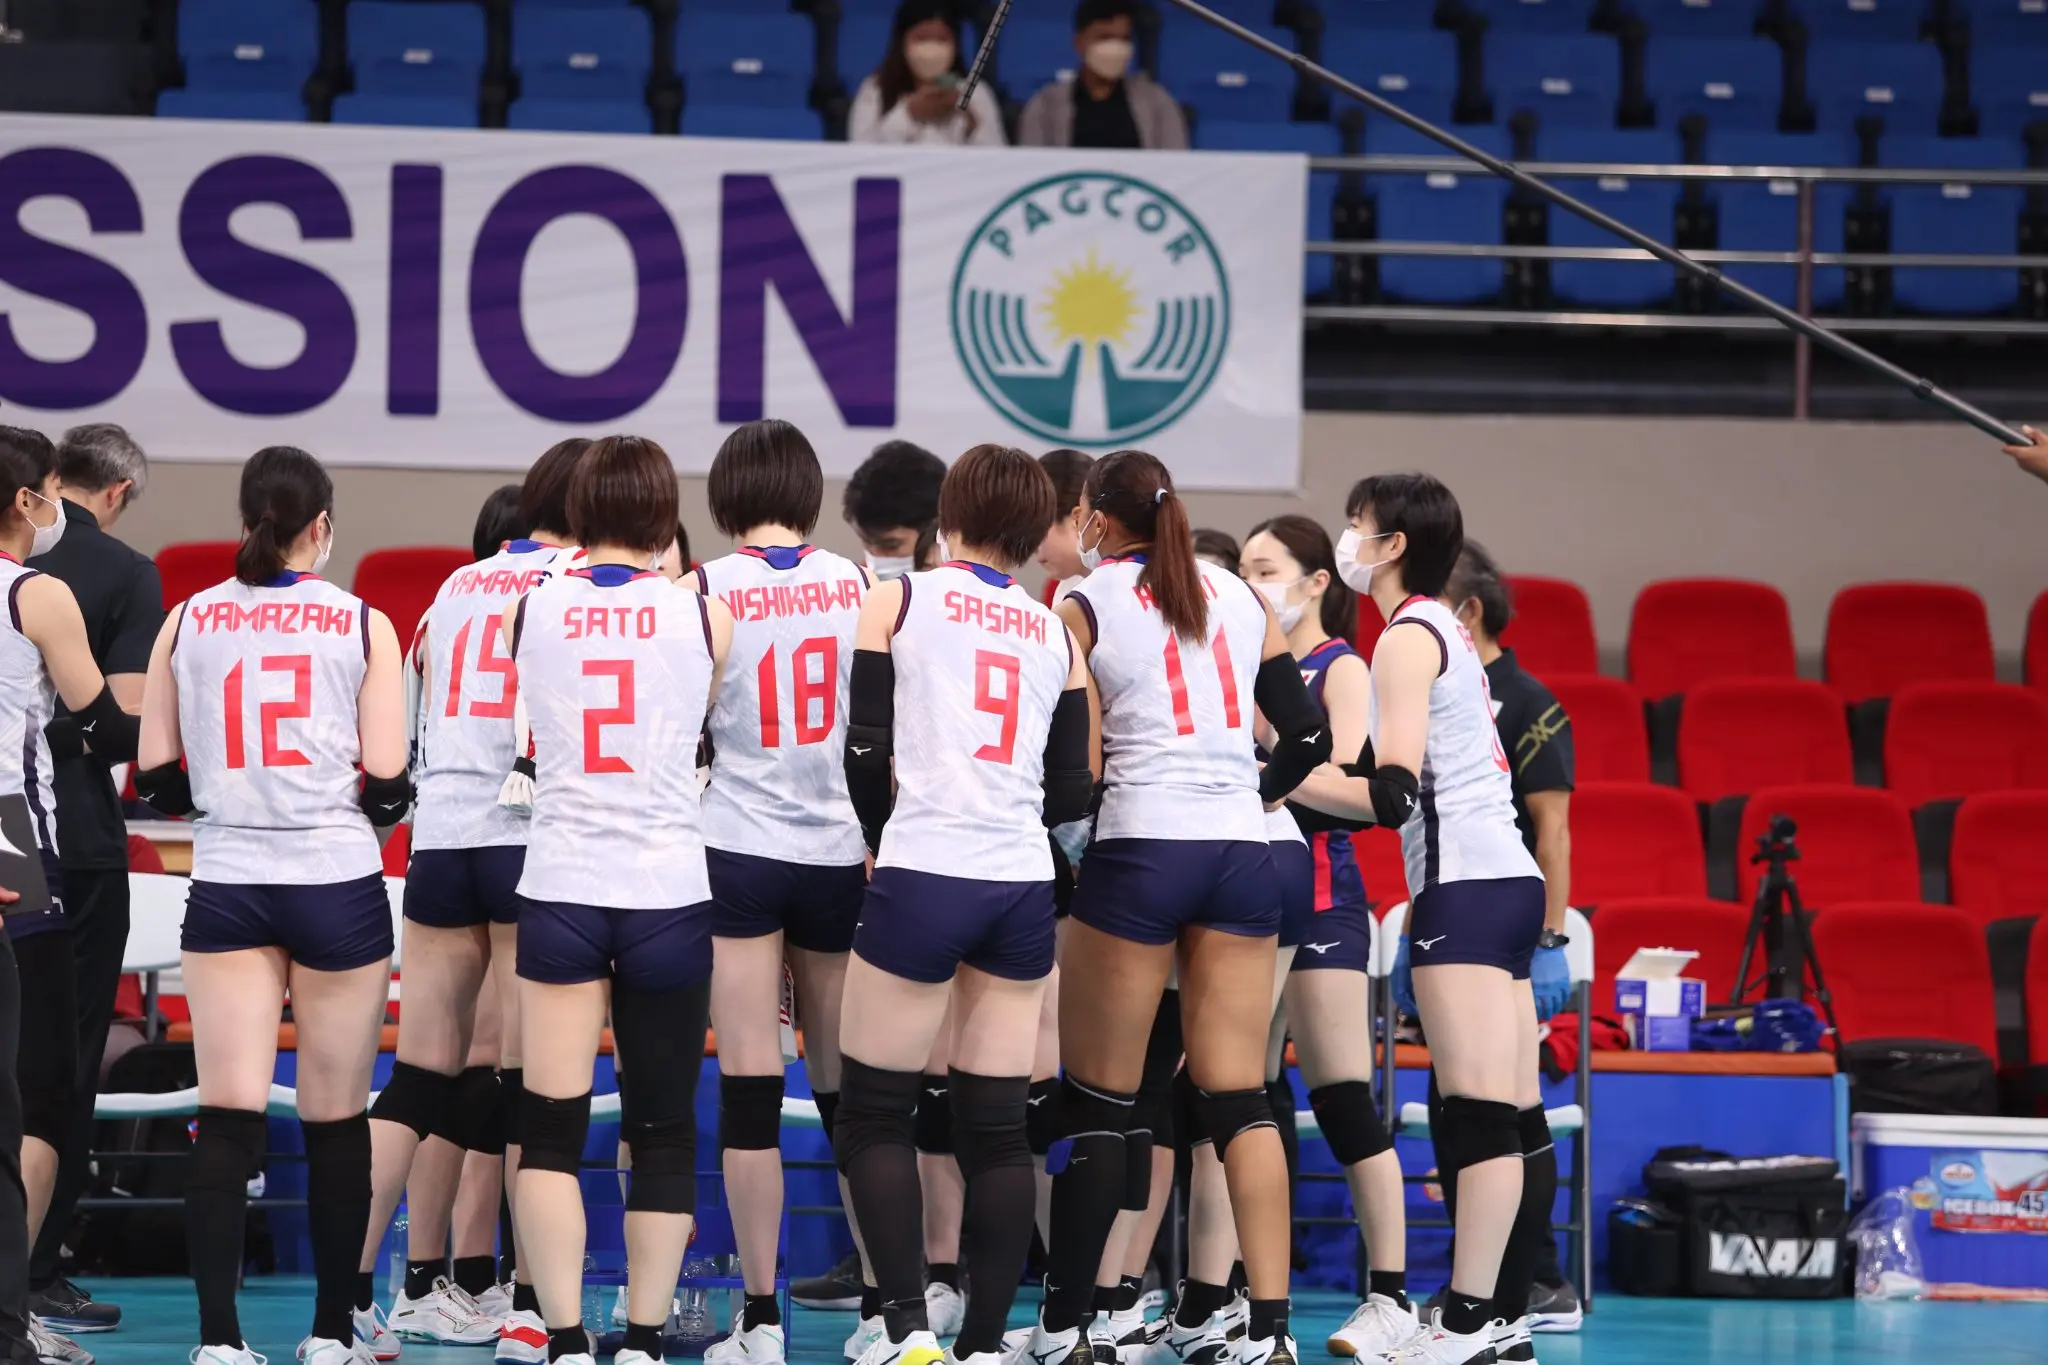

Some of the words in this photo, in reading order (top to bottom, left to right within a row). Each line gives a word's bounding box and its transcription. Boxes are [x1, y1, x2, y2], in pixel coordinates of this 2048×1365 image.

[987, 183, 1198, 264] PAGCOR
[0, 144, 902, 429] SSION
[191, 602, 353, 637] YAMAZAKI
[444, 614, 519, 719] 15
[564, 606, 656, 640] SATO
[944, 590, 1047, 647] SASAKI
[223, 655, 314, 769] 12
[582, 659, 635, 773] 2
[757, 636, 838, 748] 18
[973, 648, 1021, 766] 9
[1163, 623, 1241, 736] 11
[1709, 1231, 1838, 1279] VAAM
